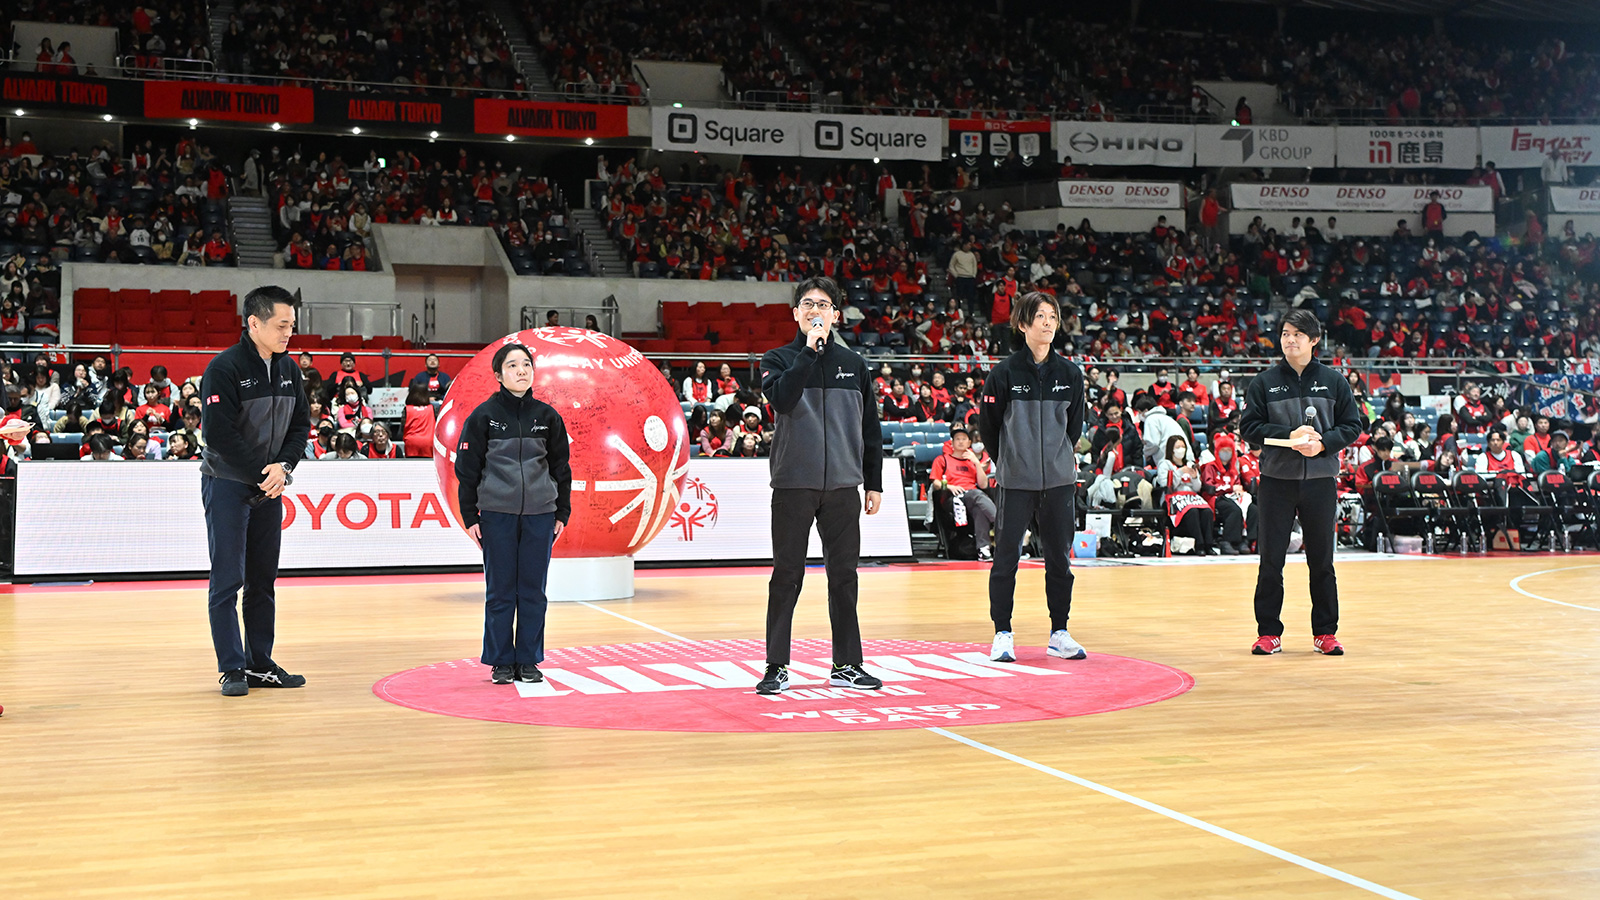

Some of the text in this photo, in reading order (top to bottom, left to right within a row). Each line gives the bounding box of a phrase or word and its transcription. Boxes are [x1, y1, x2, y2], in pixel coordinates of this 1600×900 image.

[3, 77, 108, 107] ALVARK TOKYO
[181, 88, 280, 115] ALVARK TOKYO
[348, 98, 442, 125] ALVARK TOKYO
[507, 107, 597, 131] ALVARK TOKYO
[704, 119, 785, 146] Square
[850, 126, 927, 152] Square
[1258, 129, 1289, 142] KBD
[1102, 137, 1183, 152] HINO
[1398, 141, 1444, 164] 鹿島
[1259, 147, 1313, 161] GROUP
[1069, 184, 1114, 196] DENSO
[1124, 186, 1170, 197] DENSO
[1258, 186, 1309, 198] DENSO
[1336, 188, 1386, 199] DENSO
[513, 651, 1073, 697] ALVARK
[743, 685, 926, 701] TOKYO
[760, 703, 1001, 720] WE RED
[833, 709, 963, 724] DAY
